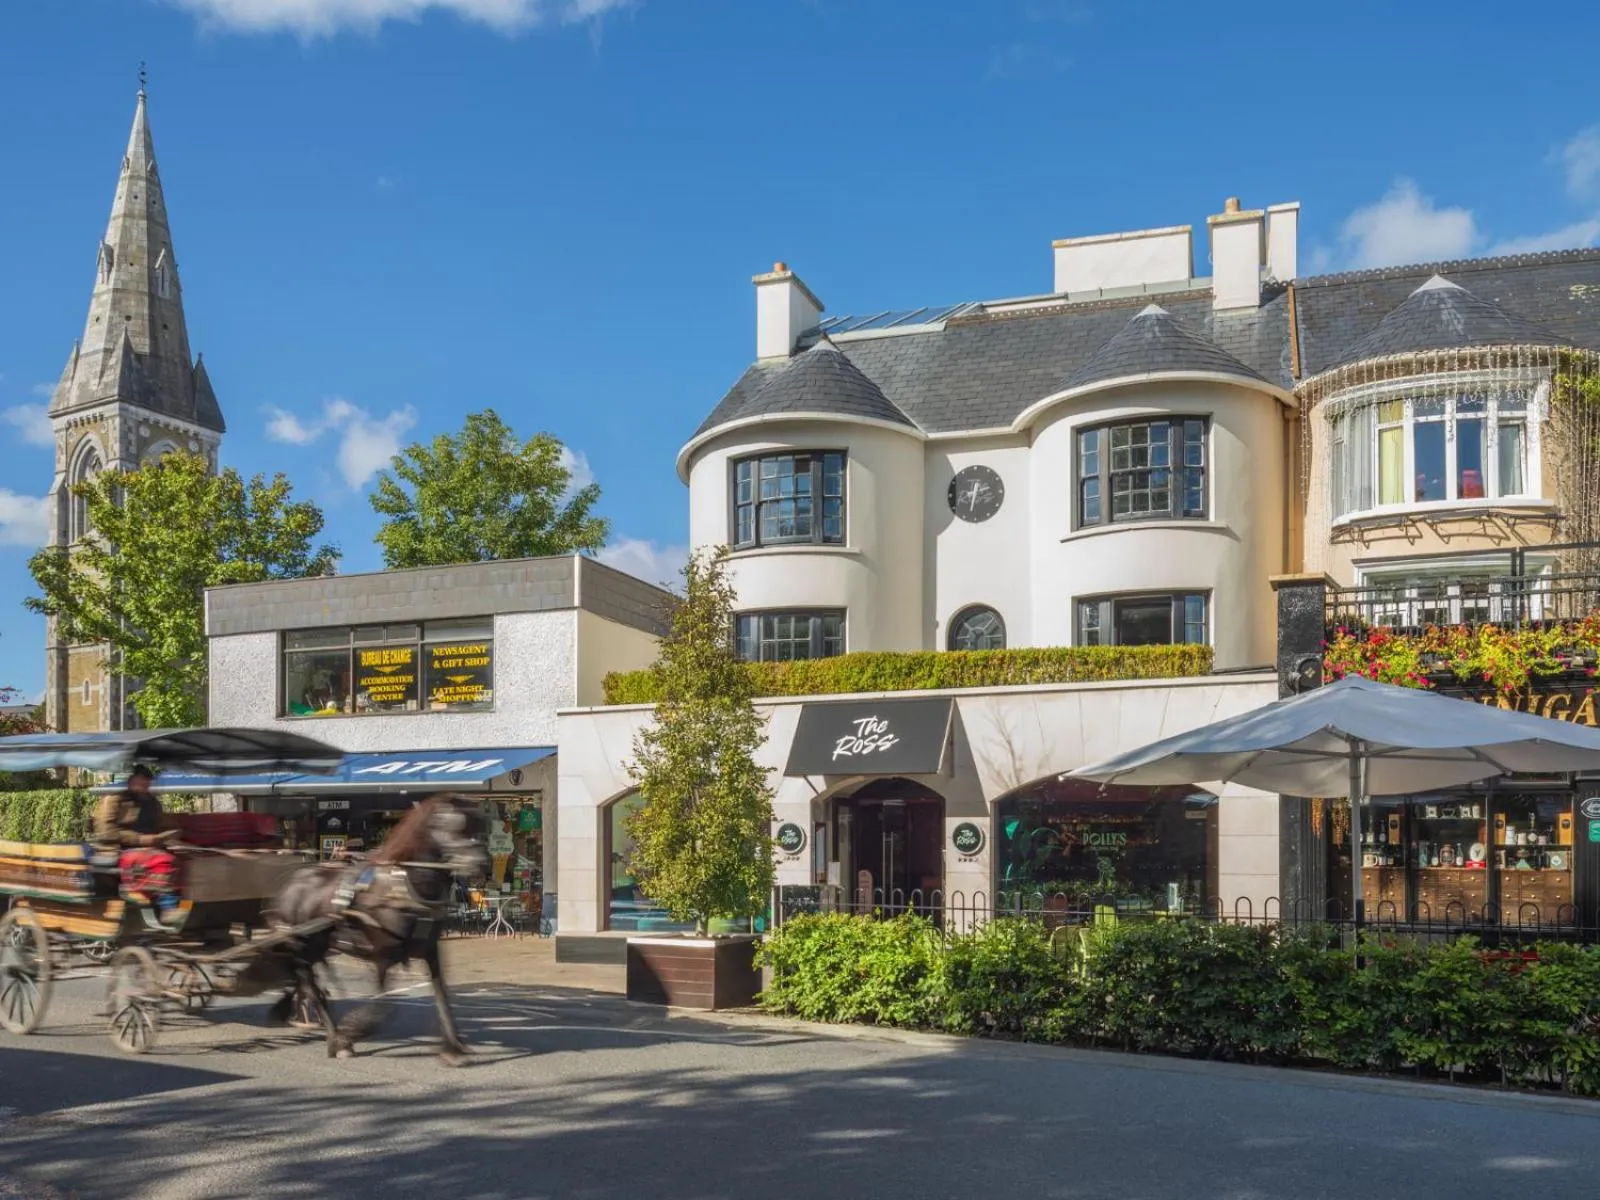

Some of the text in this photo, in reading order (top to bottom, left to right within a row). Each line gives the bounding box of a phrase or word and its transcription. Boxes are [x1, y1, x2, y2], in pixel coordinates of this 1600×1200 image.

[432, 644, 487, 656] NEWSAGENT
[361, 650, 382, 667] BUREAU
[390, 648, 412, 664] CHANGE
[433, 656, 490, 669] & GIFT SHOP
[360, 675, 414, 686] ACCOMMODATION
[368, 685, 406, 694] BOOKING
[457, 684, 485, 693] NIGHT
[371, 693, 404, 702] CENTRE
[853, 715, 889, 738] The
[352, 759, 504, 774] ATM
[327, 801, 343, 809] ATM
